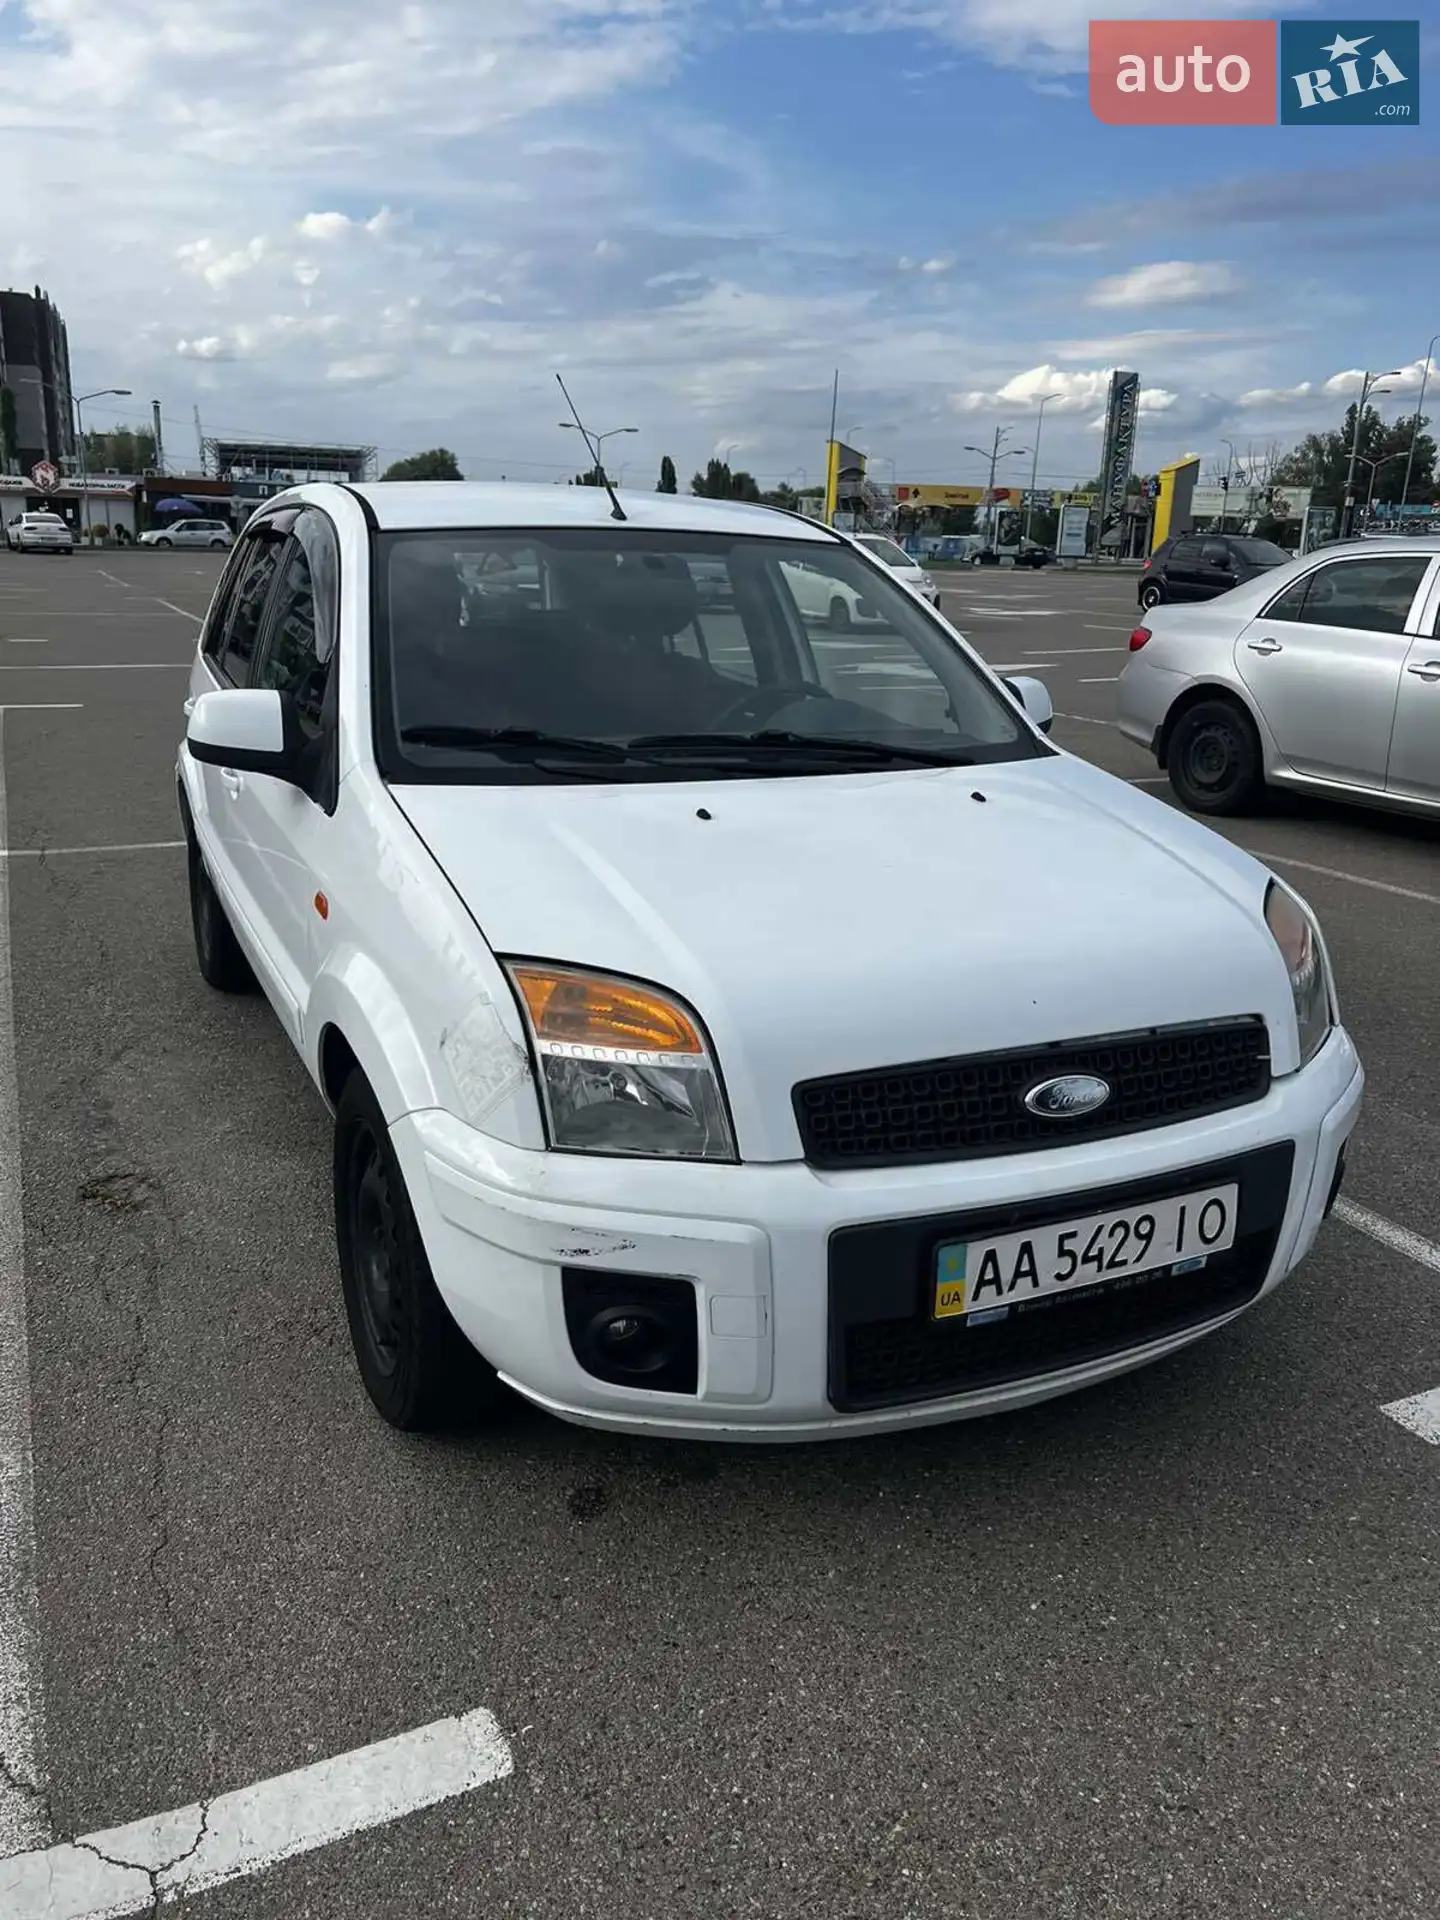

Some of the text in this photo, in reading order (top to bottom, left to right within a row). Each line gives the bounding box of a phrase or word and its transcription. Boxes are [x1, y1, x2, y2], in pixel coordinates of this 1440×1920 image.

[1109, 383, 1135, 526] МАНУФАКТУРА
[941, 1292, 961, 1307] UA
[971, 1240, 1039, 1301] AA
[1053, 1214, 1156, 1282] 5429
[1175, 1198, 1227, 1252] IO
